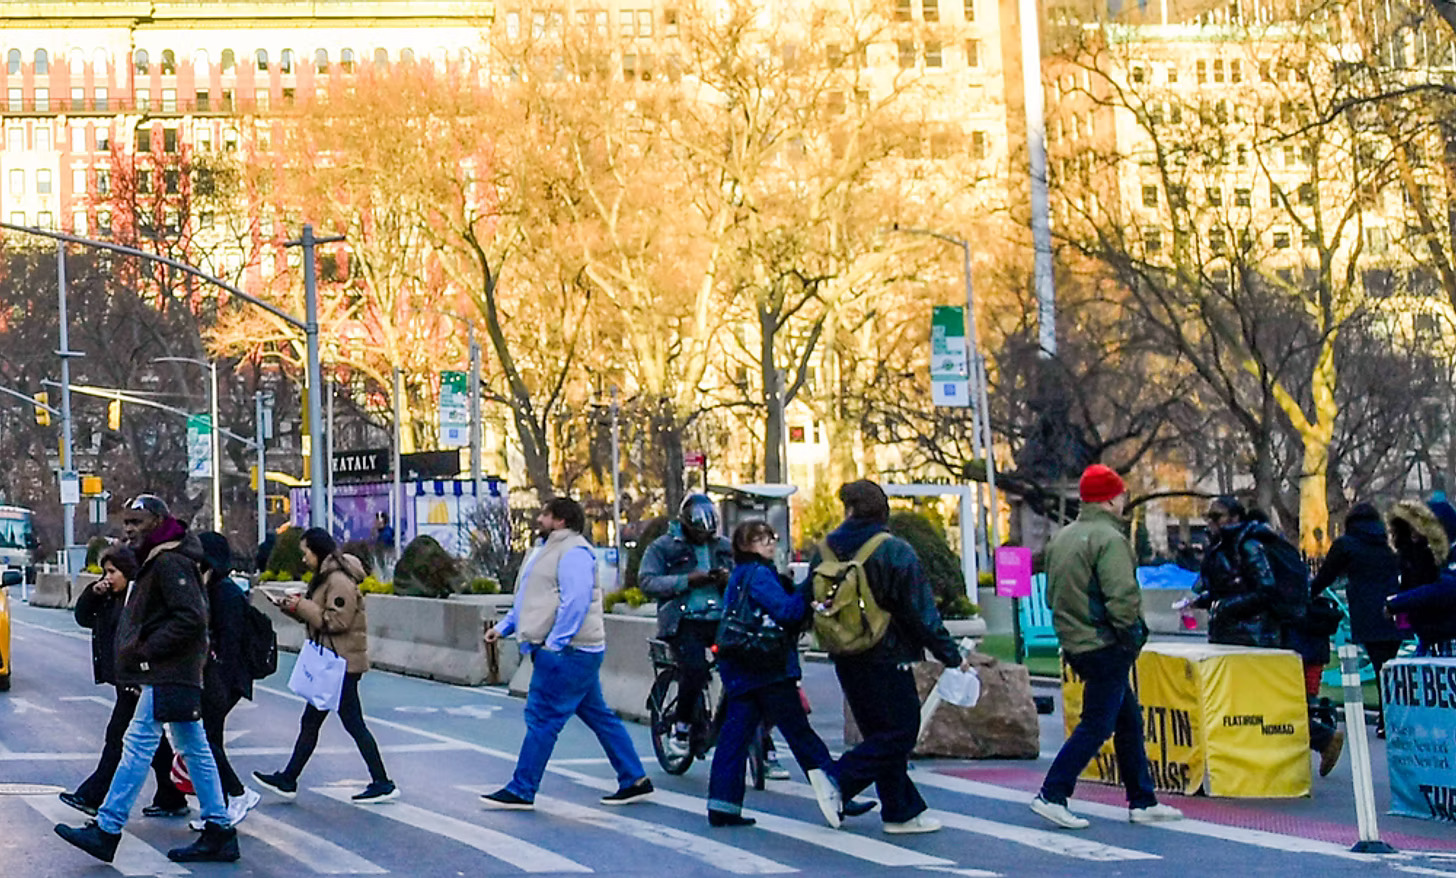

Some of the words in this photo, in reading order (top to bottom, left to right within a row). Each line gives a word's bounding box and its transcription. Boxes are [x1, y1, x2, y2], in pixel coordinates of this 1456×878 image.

[332, 454, 377, 472] EATALY
[1383, 666, 1421, 706] THE
[1170, 708, 1193, 748] IN
[1223, 715, 1264, 727] FLATIRON
[1261, 723, 1295, 735] NOMAD
